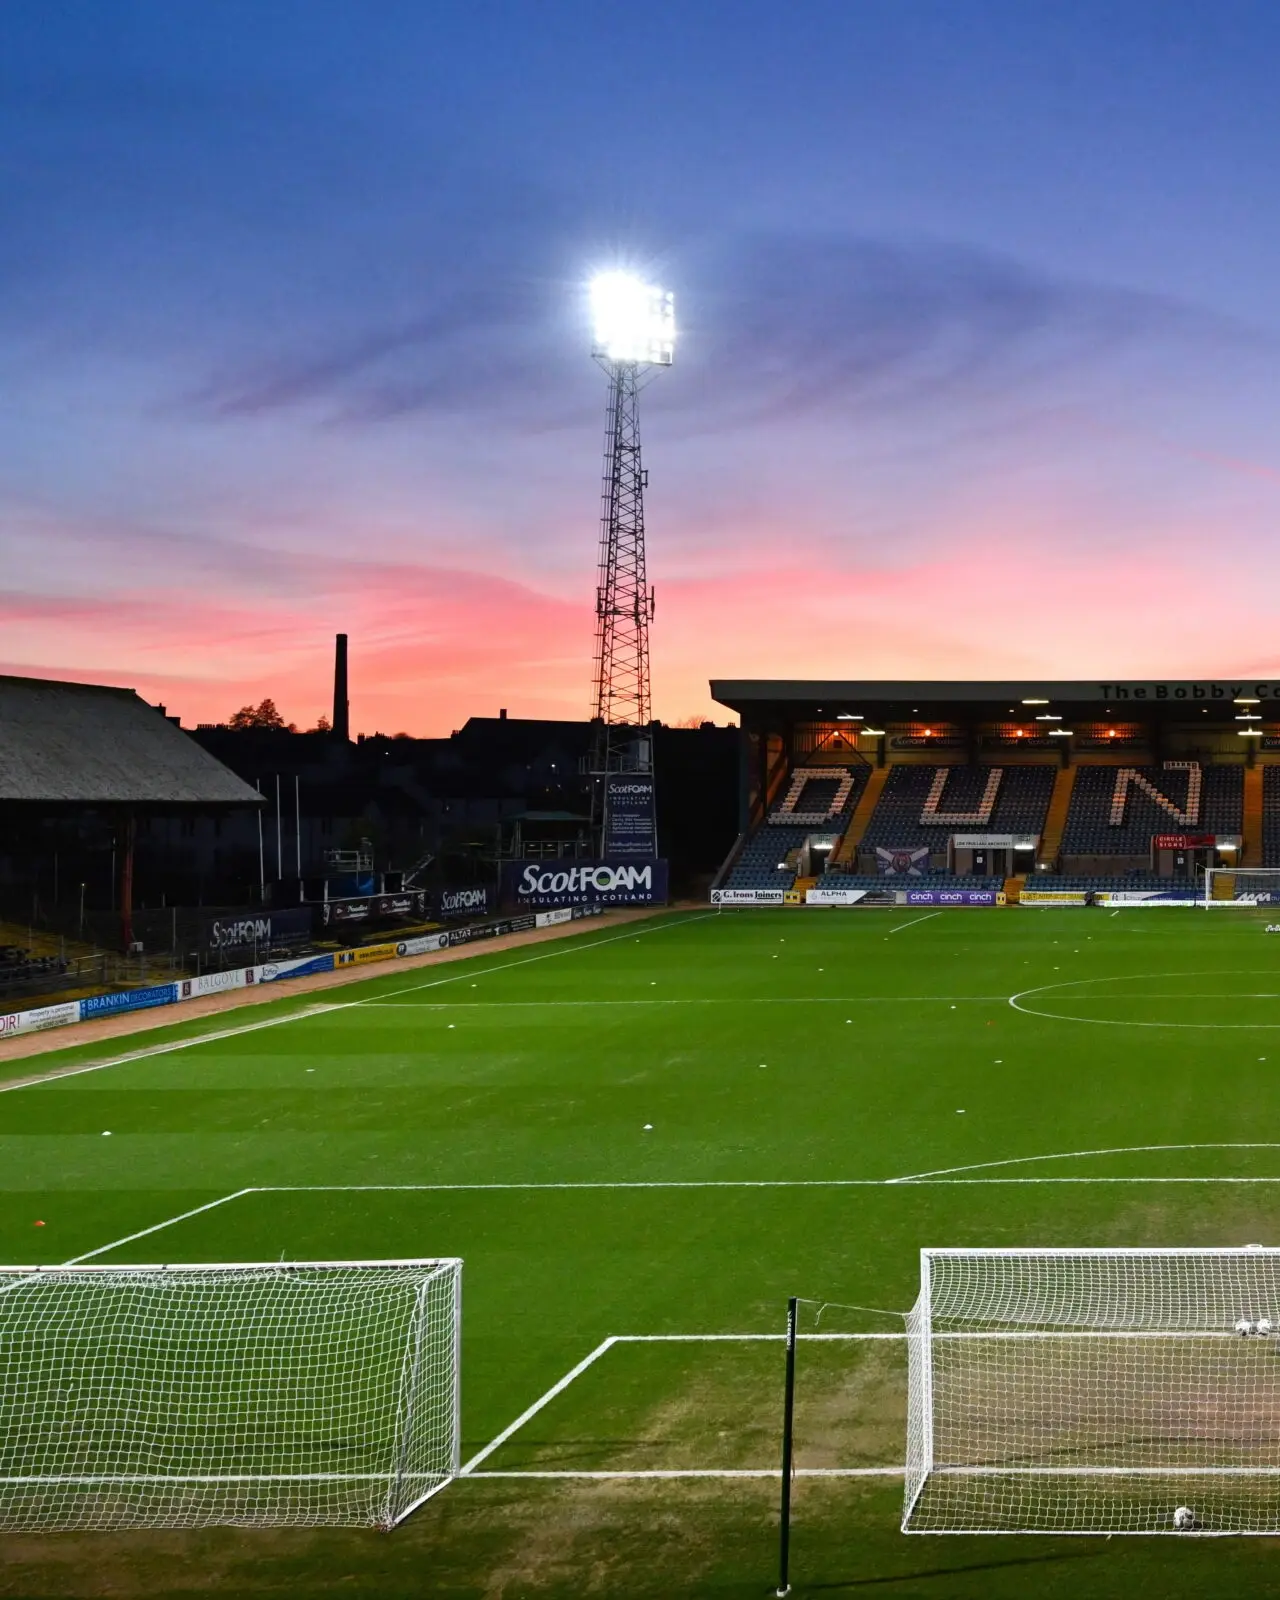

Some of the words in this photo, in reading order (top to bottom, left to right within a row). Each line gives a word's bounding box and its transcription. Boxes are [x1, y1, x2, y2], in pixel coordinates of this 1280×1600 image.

[1099, 684, 1148, 699] The
[1155, 684, 1242, 700] Bobby
[608, 783, 653, 794] ScotFOAM
[517, 864, 653, 895] ScotFOAM
[440, 887, 487, 911] ScotFOAM
[517, 893, 588, 904] INSULATING
[595, 893, 653, 904] SCOTLAND
[755, 891, 782, 899] Joiners
[910, 892, 933, 900] cinch
[940, 892, 962, 901] cinch
[969, 892, 992, 901] cinch
[88, 993, 130, 1010] BRANKIN
[130, 987, 173, 1003] DECORATORS
